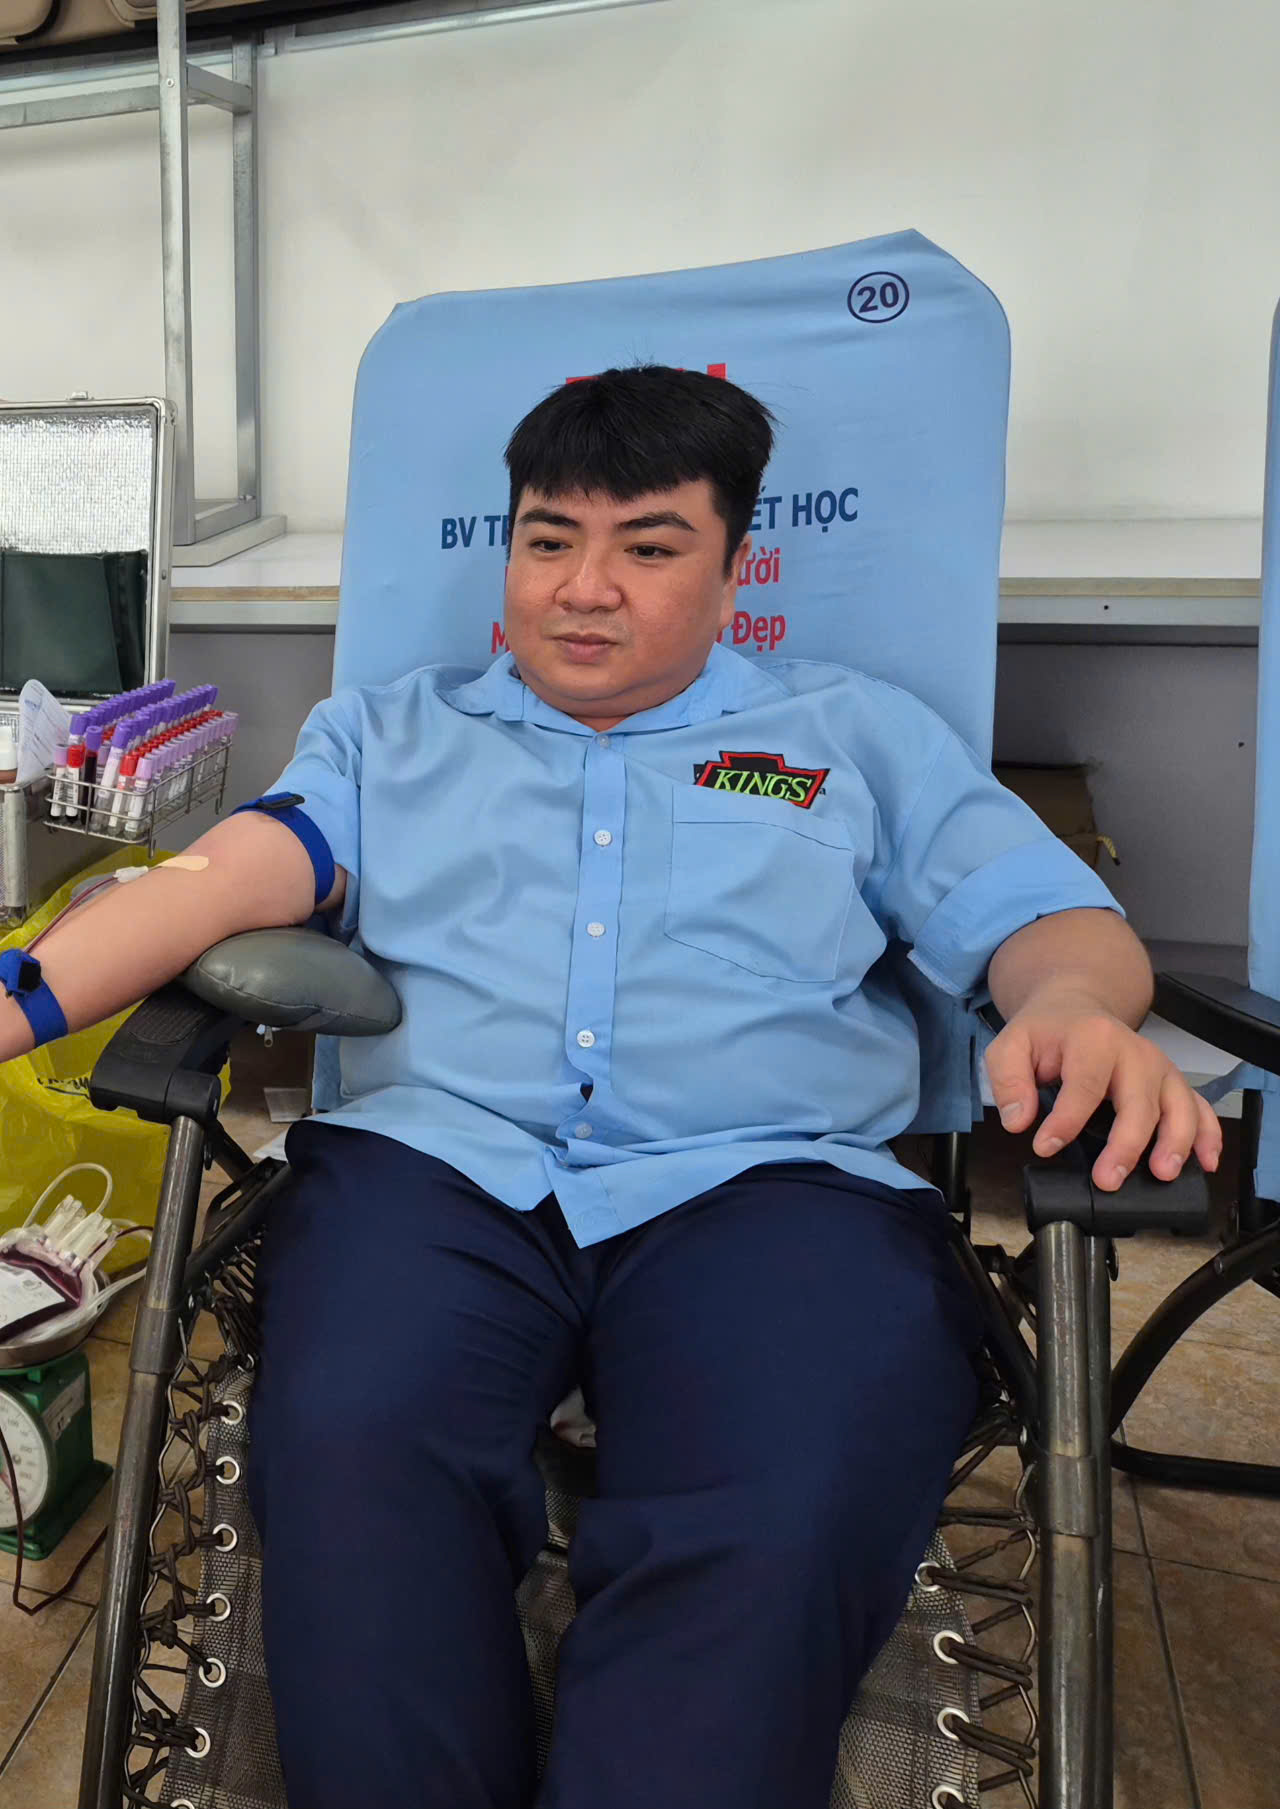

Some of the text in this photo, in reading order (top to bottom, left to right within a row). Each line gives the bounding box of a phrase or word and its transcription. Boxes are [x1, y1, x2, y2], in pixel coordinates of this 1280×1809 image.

[857, 281, 900, 313] 20
[441, 516, 477, 549] BV
[792, 487, 859, 533] HỌC
[731, 611, 786, 652] Đẹp
[713, 769, 812, 802] KINGS
